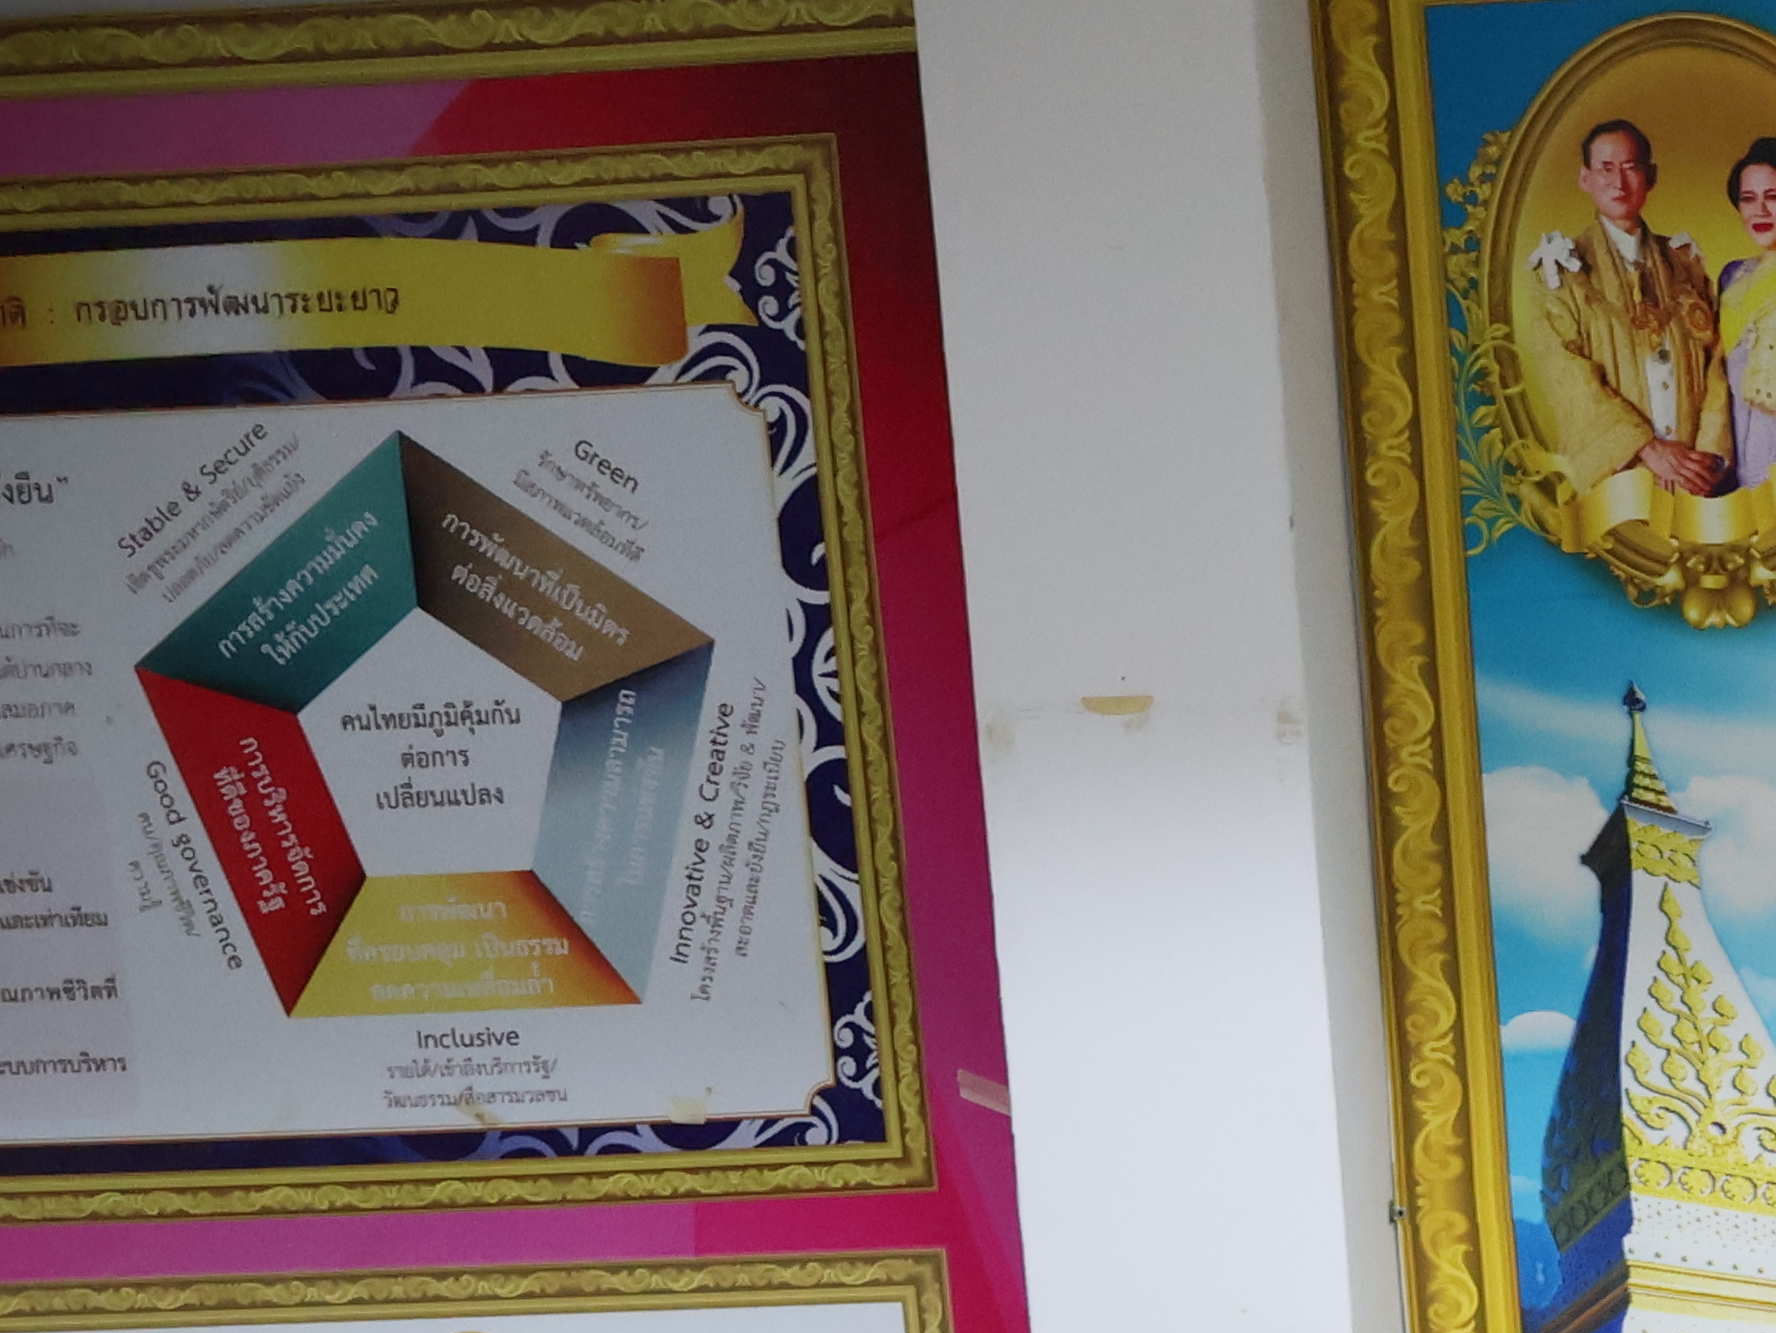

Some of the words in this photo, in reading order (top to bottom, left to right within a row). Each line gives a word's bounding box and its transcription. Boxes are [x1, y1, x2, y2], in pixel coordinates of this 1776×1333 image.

[117, 500, 183, 558] Stable
[180, 481, 202, 502] &
[199, 422, 269, 485] Secure
[574, 439, 640, 494] Green
[341, 699, 522, 738] คนไทยมีภูมิคุ้มกัน
[401, 744, 471, 769] ต่อการ
[700, 701, 736, 803] Creative
[376, 776, 506, 812] เปลี่ยนแปลง
[694, 812, 716, 830] &
[146, 759, 188, 826] Good
[171, 832, 243, 971] governance
[670, 836, 712, 965] Innovative
[416, 1027, 520, 1051] Inclusive
